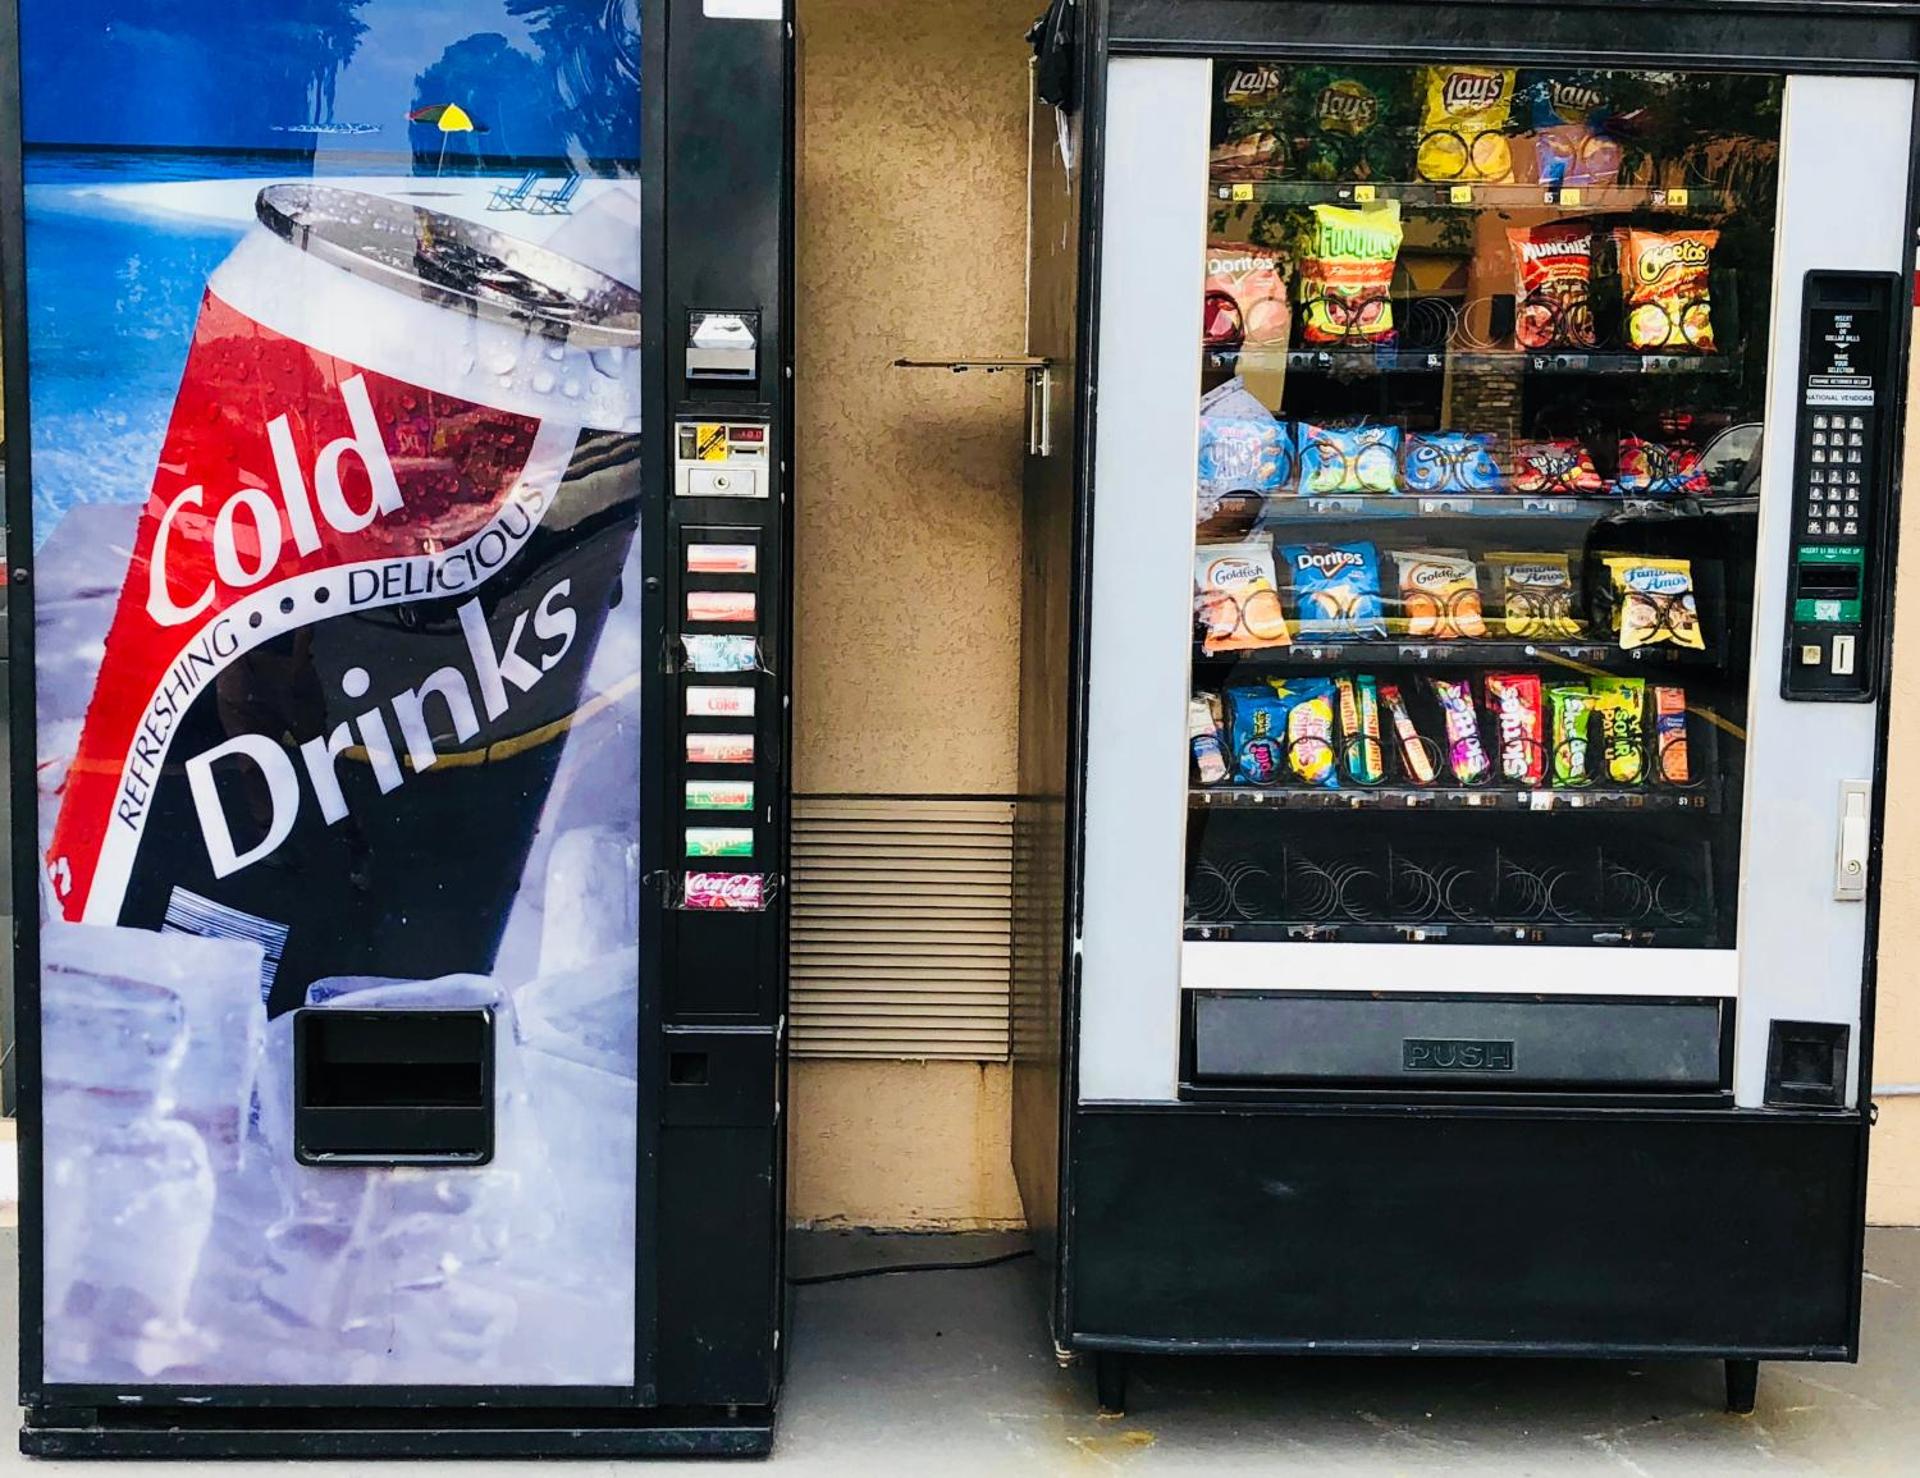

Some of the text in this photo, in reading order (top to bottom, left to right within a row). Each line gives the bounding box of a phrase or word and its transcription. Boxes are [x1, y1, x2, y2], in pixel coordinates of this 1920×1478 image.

[1841, 394, 1873, 402] VENDORS
[146, 373, 405, 627] Cold
[348, 481, 545, 605] DELICIOUS
[1297, 551, 1364, 570] Doritos
[1215, 565, 1264, 585] Goldfish
[1642, 576, 1688, 591] Amos
[708, 699, 740, 711] Coke
[116, 618, 239, 831] REFRESHING
[184, 578, 578, 880] Drinks
[1500, 687, 1528, 778] Skittles
[1407, 1045, 1511, 1069] PUSH
